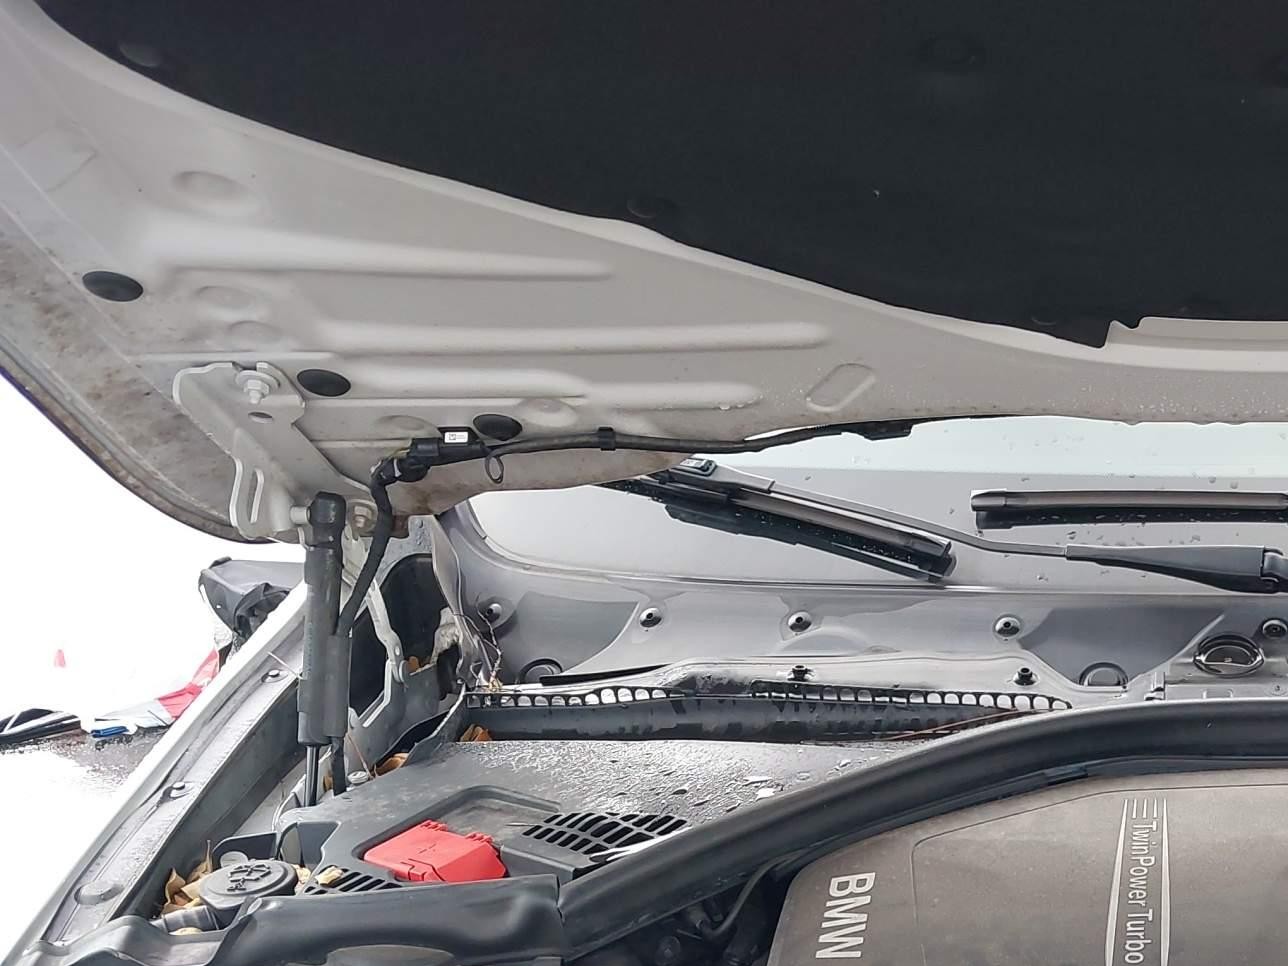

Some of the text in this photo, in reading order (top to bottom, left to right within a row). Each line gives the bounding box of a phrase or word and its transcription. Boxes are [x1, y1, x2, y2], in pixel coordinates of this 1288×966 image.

[815, 872, 876, 959] BMW
[1124, 820, 1157, 965] TwinPower Turbo
